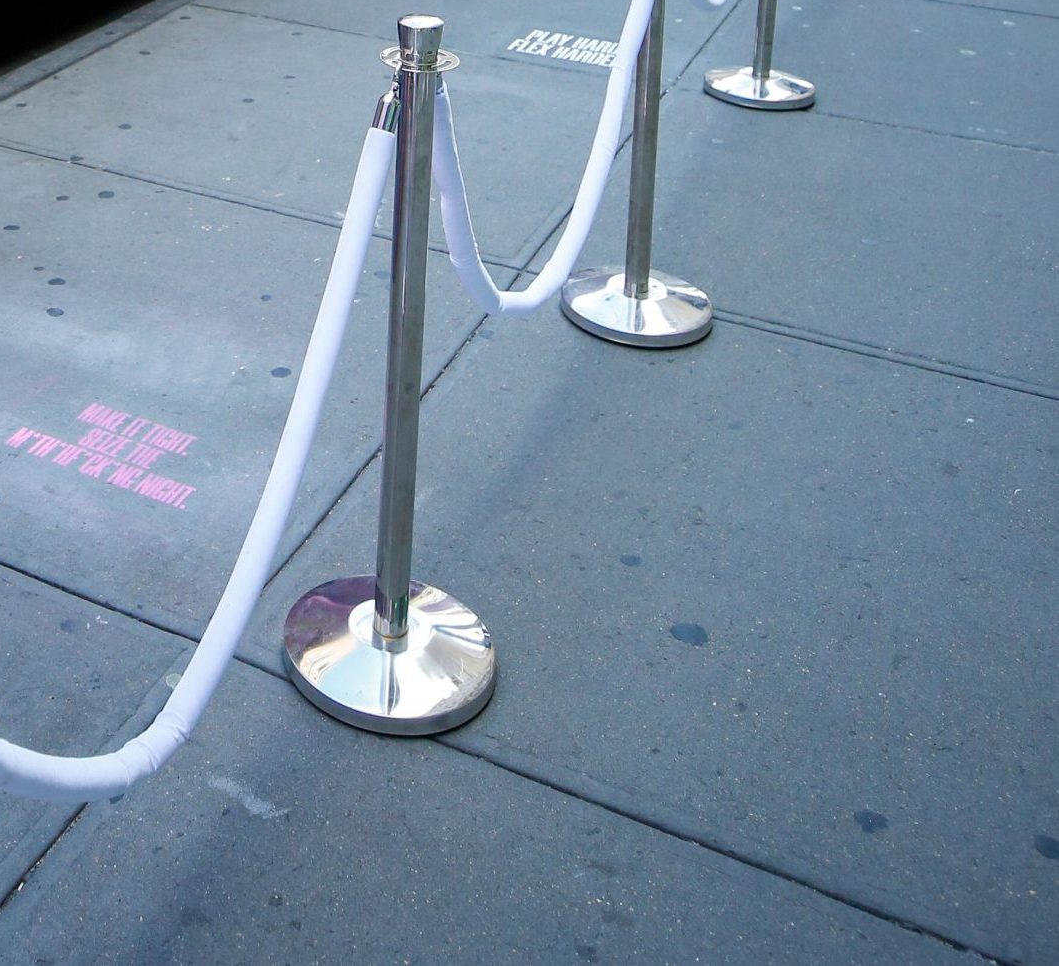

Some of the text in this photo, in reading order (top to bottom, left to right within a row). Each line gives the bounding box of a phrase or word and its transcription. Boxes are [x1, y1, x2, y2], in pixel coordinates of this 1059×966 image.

[507, 38, 554, 56] FLEX
[524, 29, 575, 47] PLAY
[77, 402, 198, 456] MAKE IT TIGHT.
[77, 428, 166, 470] SEIZE THE
[135, 472, 197, 510] NIGHT.
